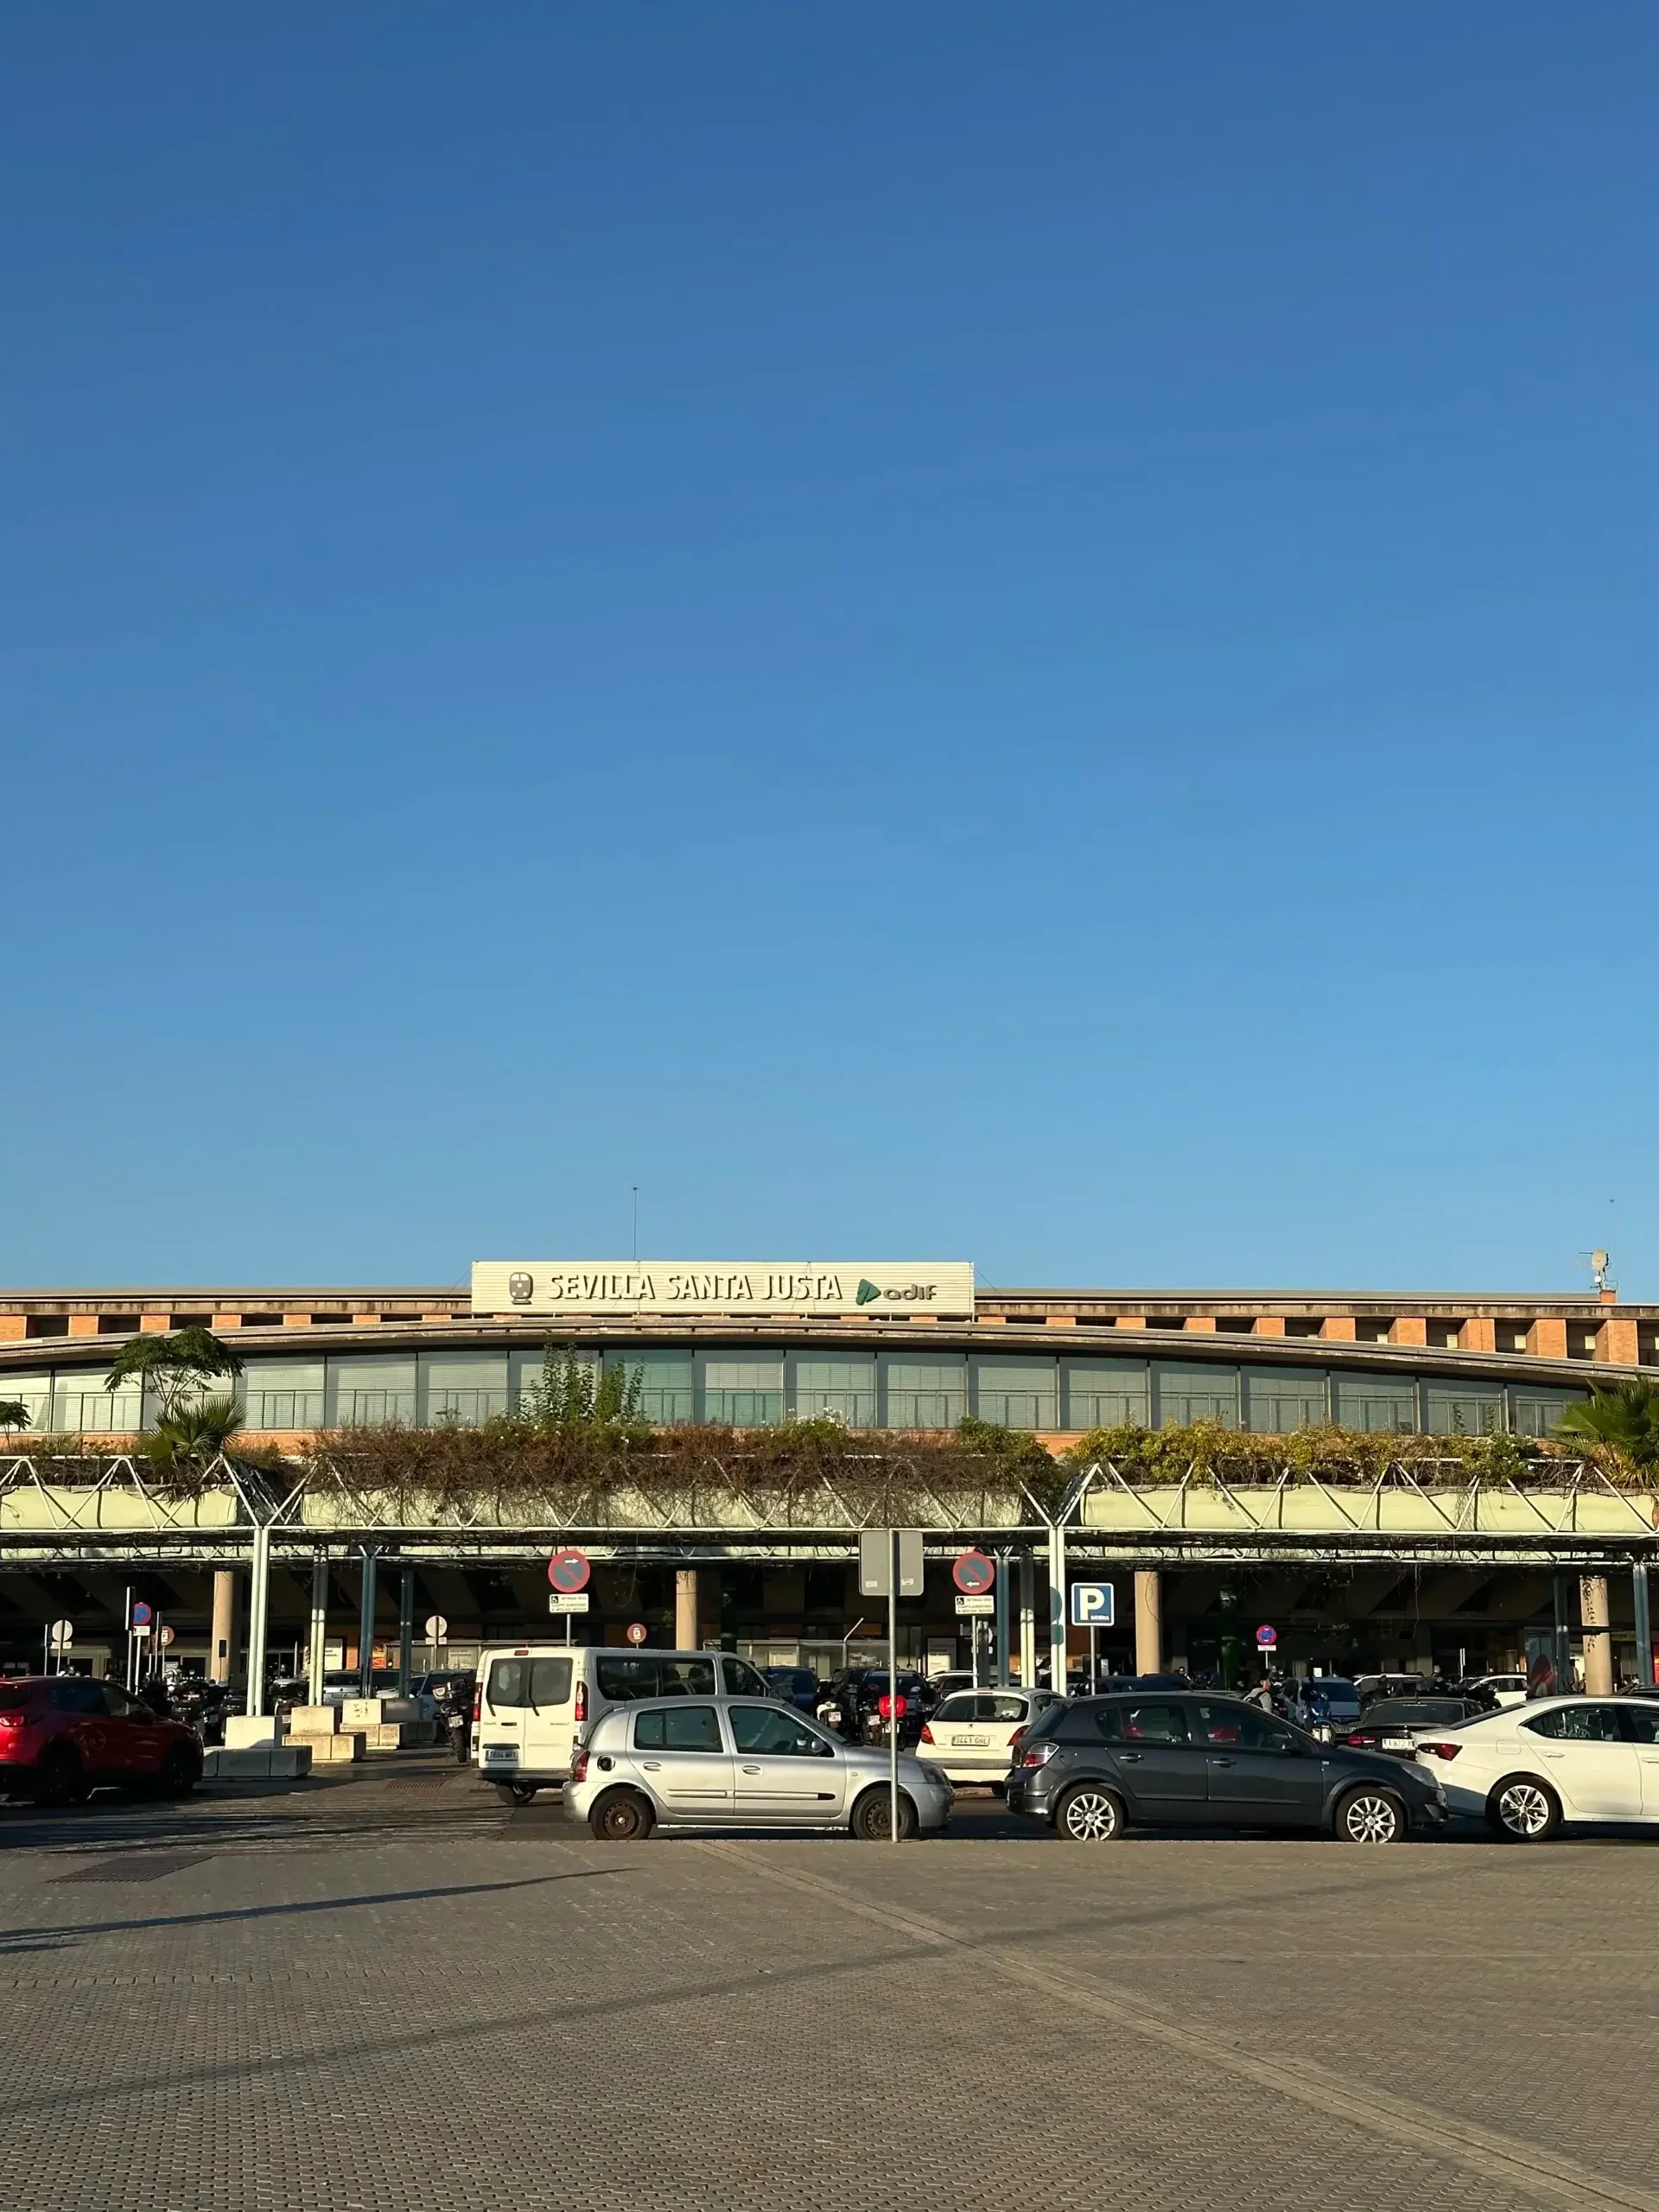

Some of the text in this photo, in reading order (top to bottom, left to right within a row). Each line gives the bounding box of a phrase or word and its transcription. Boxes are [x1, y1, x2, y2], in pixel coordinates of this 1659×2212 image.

[549, 1274, 842, 1300] SEVILLA SANTA JUSTA
[883, 1284, 938, 1300] adif
[1079, 1587, 1105, 1621] P
